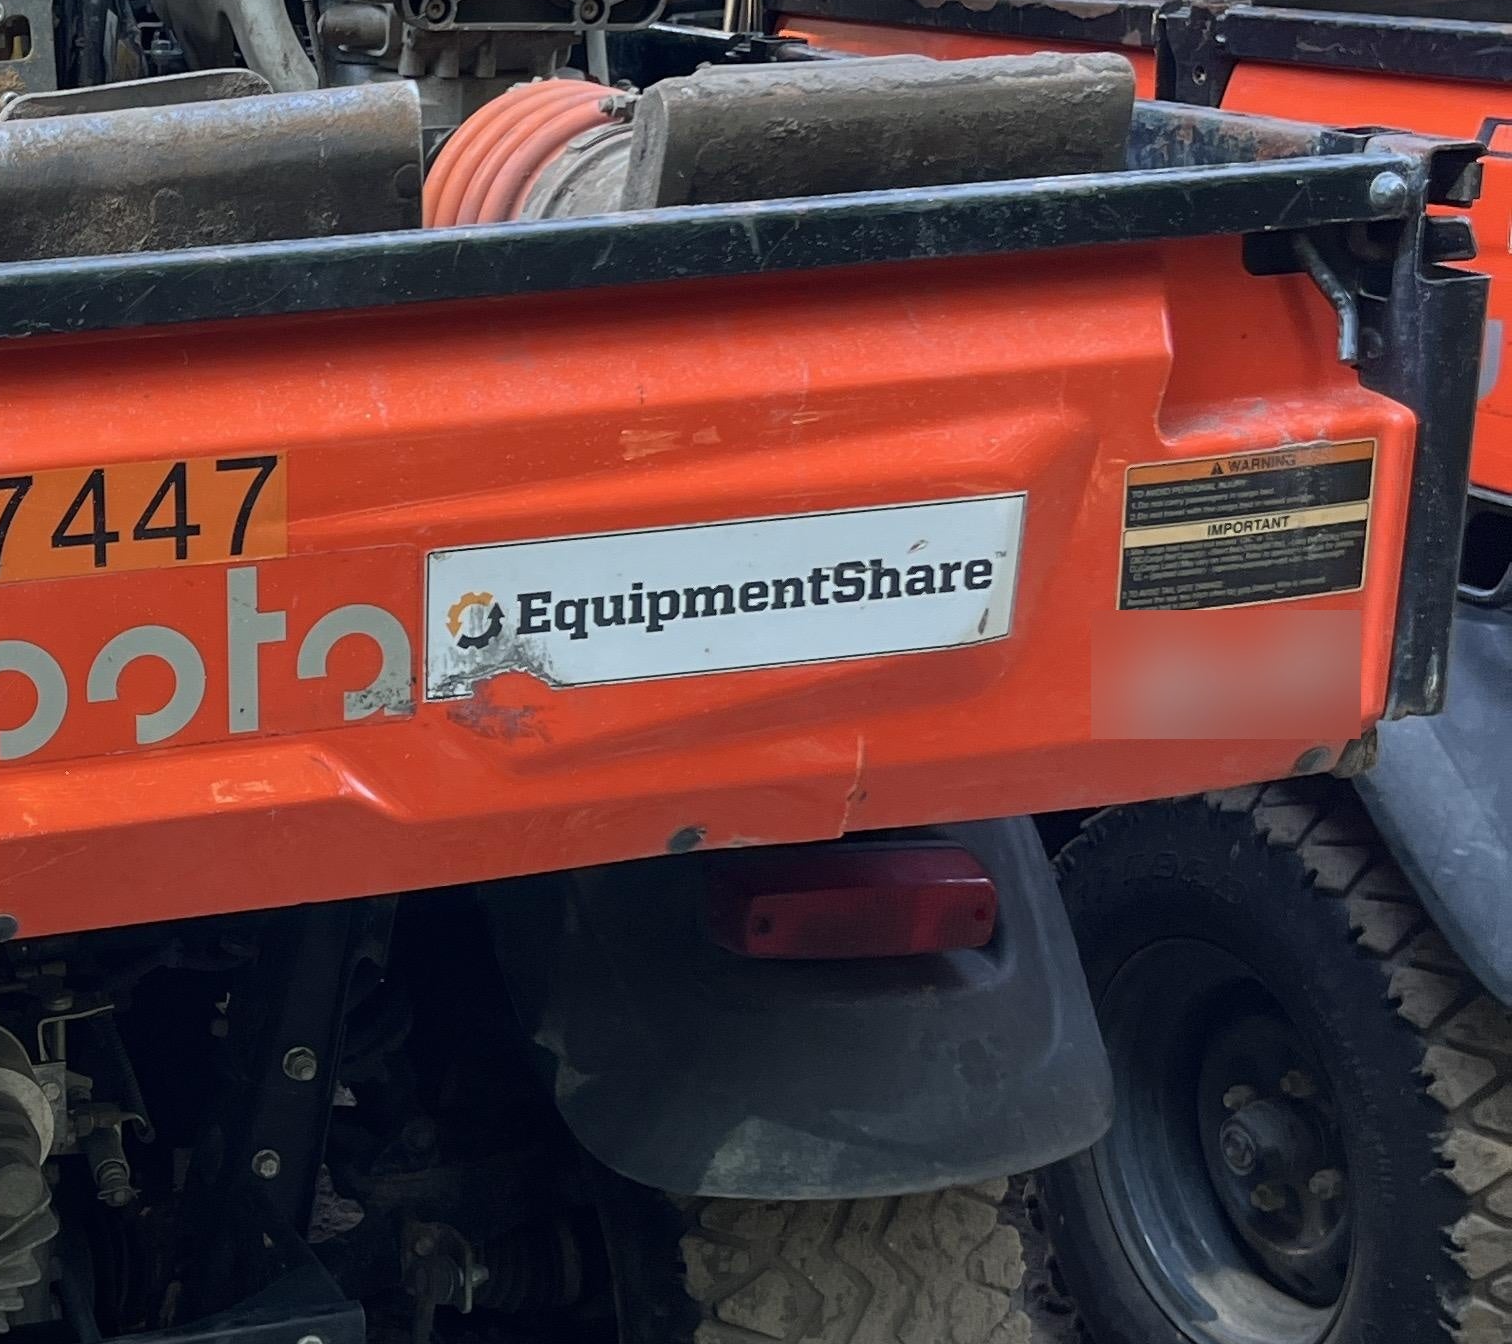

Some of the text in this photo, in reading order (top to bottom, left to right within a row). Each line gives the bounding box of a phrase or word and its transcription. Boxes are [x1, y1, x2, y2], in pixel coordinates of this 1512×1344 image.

[1227, 455, 1297, 474] WARNING
[1207, 516, 1291, 538] IMPORTANT
[516, 557, 992, 640] EquipmentShare
